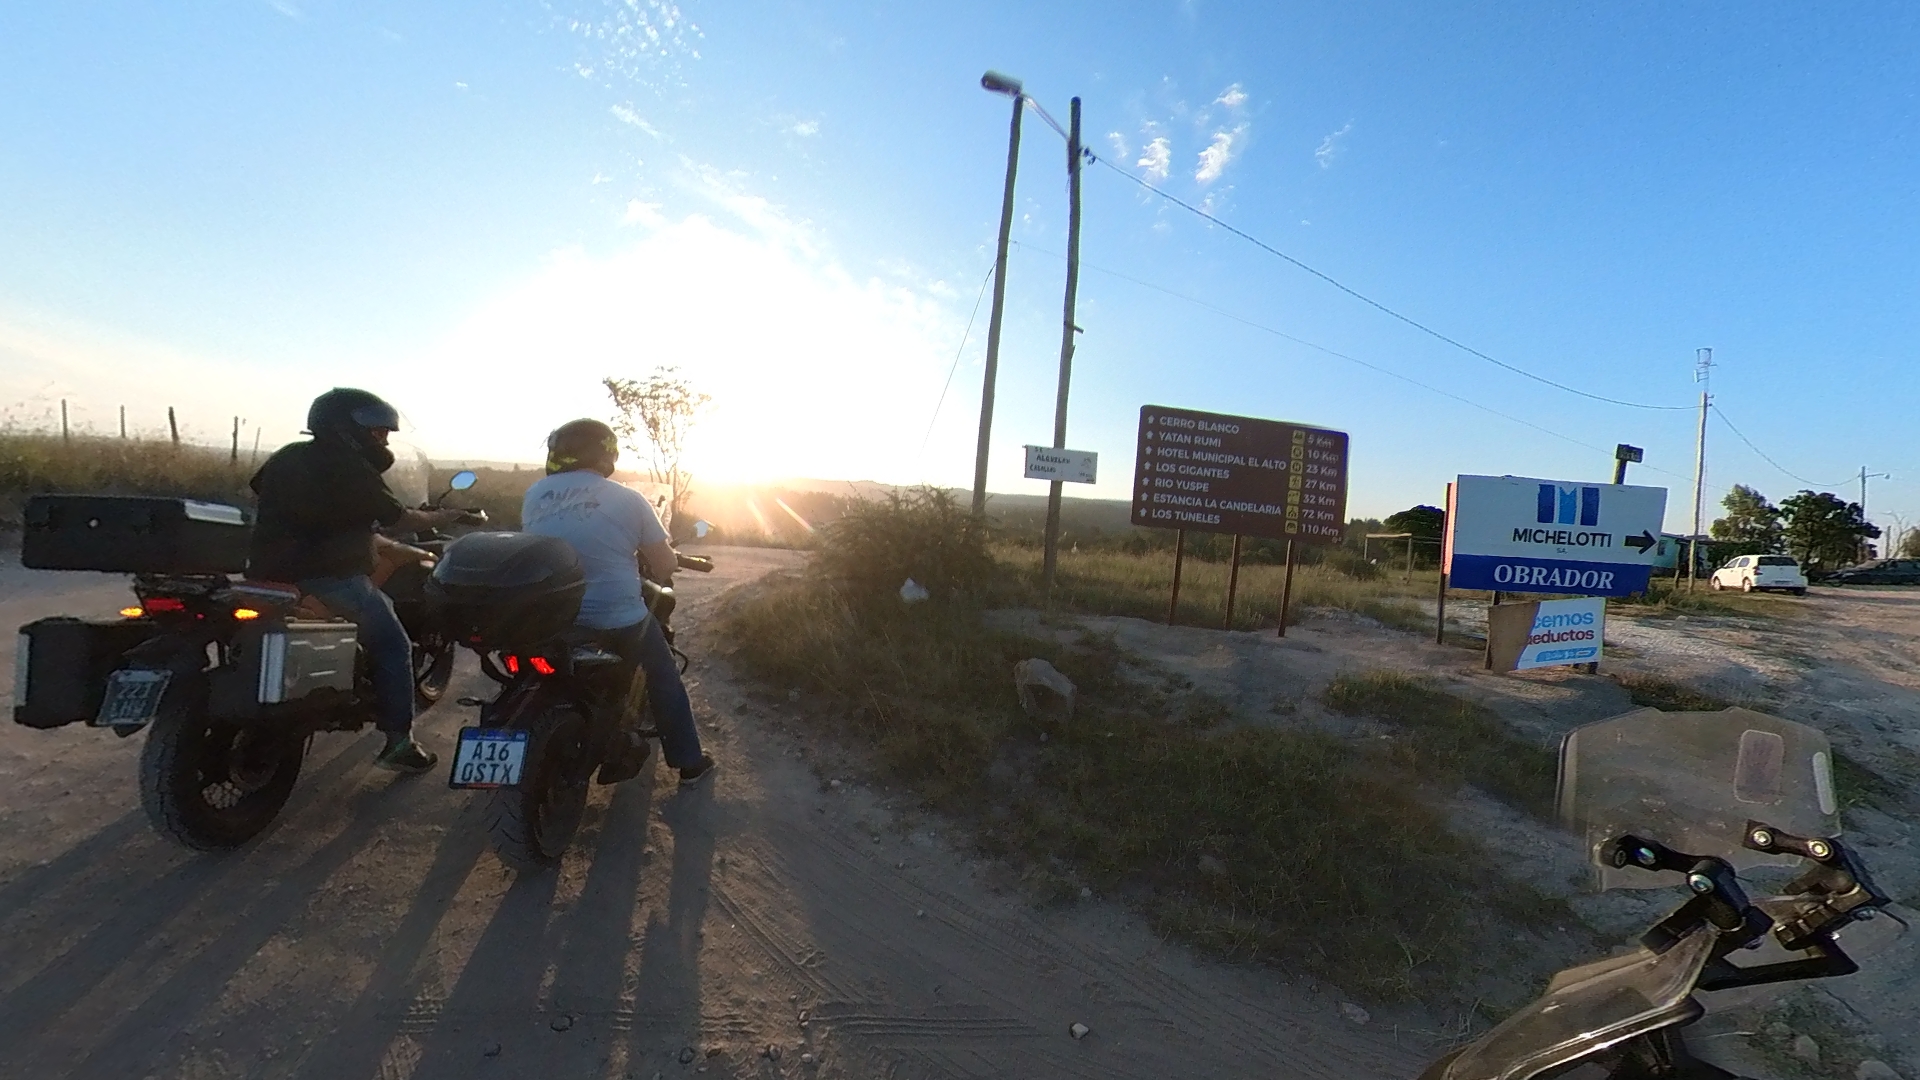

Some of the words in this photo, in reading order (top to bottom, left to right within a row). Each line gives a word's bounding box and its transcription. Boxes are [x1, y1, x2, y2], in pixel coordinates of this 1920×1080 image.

[1160, 416, 1195, 429] CERRO
[1198, 420, 1240, 434] BLANCO
[1159, 431, 1192, 444] YATAN
[1194, 436, 1222, 448] RUMI
[1157, 447, 1190, 460] HOTEL
[1192, 451, 1245, 466] MUNICIPAL
[1248, 458, 1260, 468] EL
[1262, 459, 1286, 470] ALTO
[1307, 449, 1320, 459] 10
[1156, 462, 1176, 473] LOS
[1178, 464, 1230, 479] GIGANTES
[1306, 464, 1318, 474] 23
[1320, 467, 1337, 478] Km
[1155, 478, 1173, 488] RIO
[1176, 480, 1210, 492] YUSPE
[1305, 480, 1318, 489] 27
[1319, 482, 1336, 491] Km
[1153, 493, 1204, 506] ESTANCIA
[1205, 498, 1217, 508] LA
[1220, 500, 1282, 515] CANDELARIA
[1303, 495, 1316, 504] 32
[1318, 496, 1336, 506] Km
[1152, 508, 1172, 520] LOS
[1175, 510, 1220, 524] TUNELES
[1302, 509, 1315, 519] 72
[1317, 511, 1334, 521] Km
[1302, 524, 1319, 533] 110
[1321, 526, 1338, 536] Km
[1512, 528, 1612, 547] MICHELOTTI
[1494, 564, 1615, 590] OBRADOR
[472, 742, 509, 761] A16
